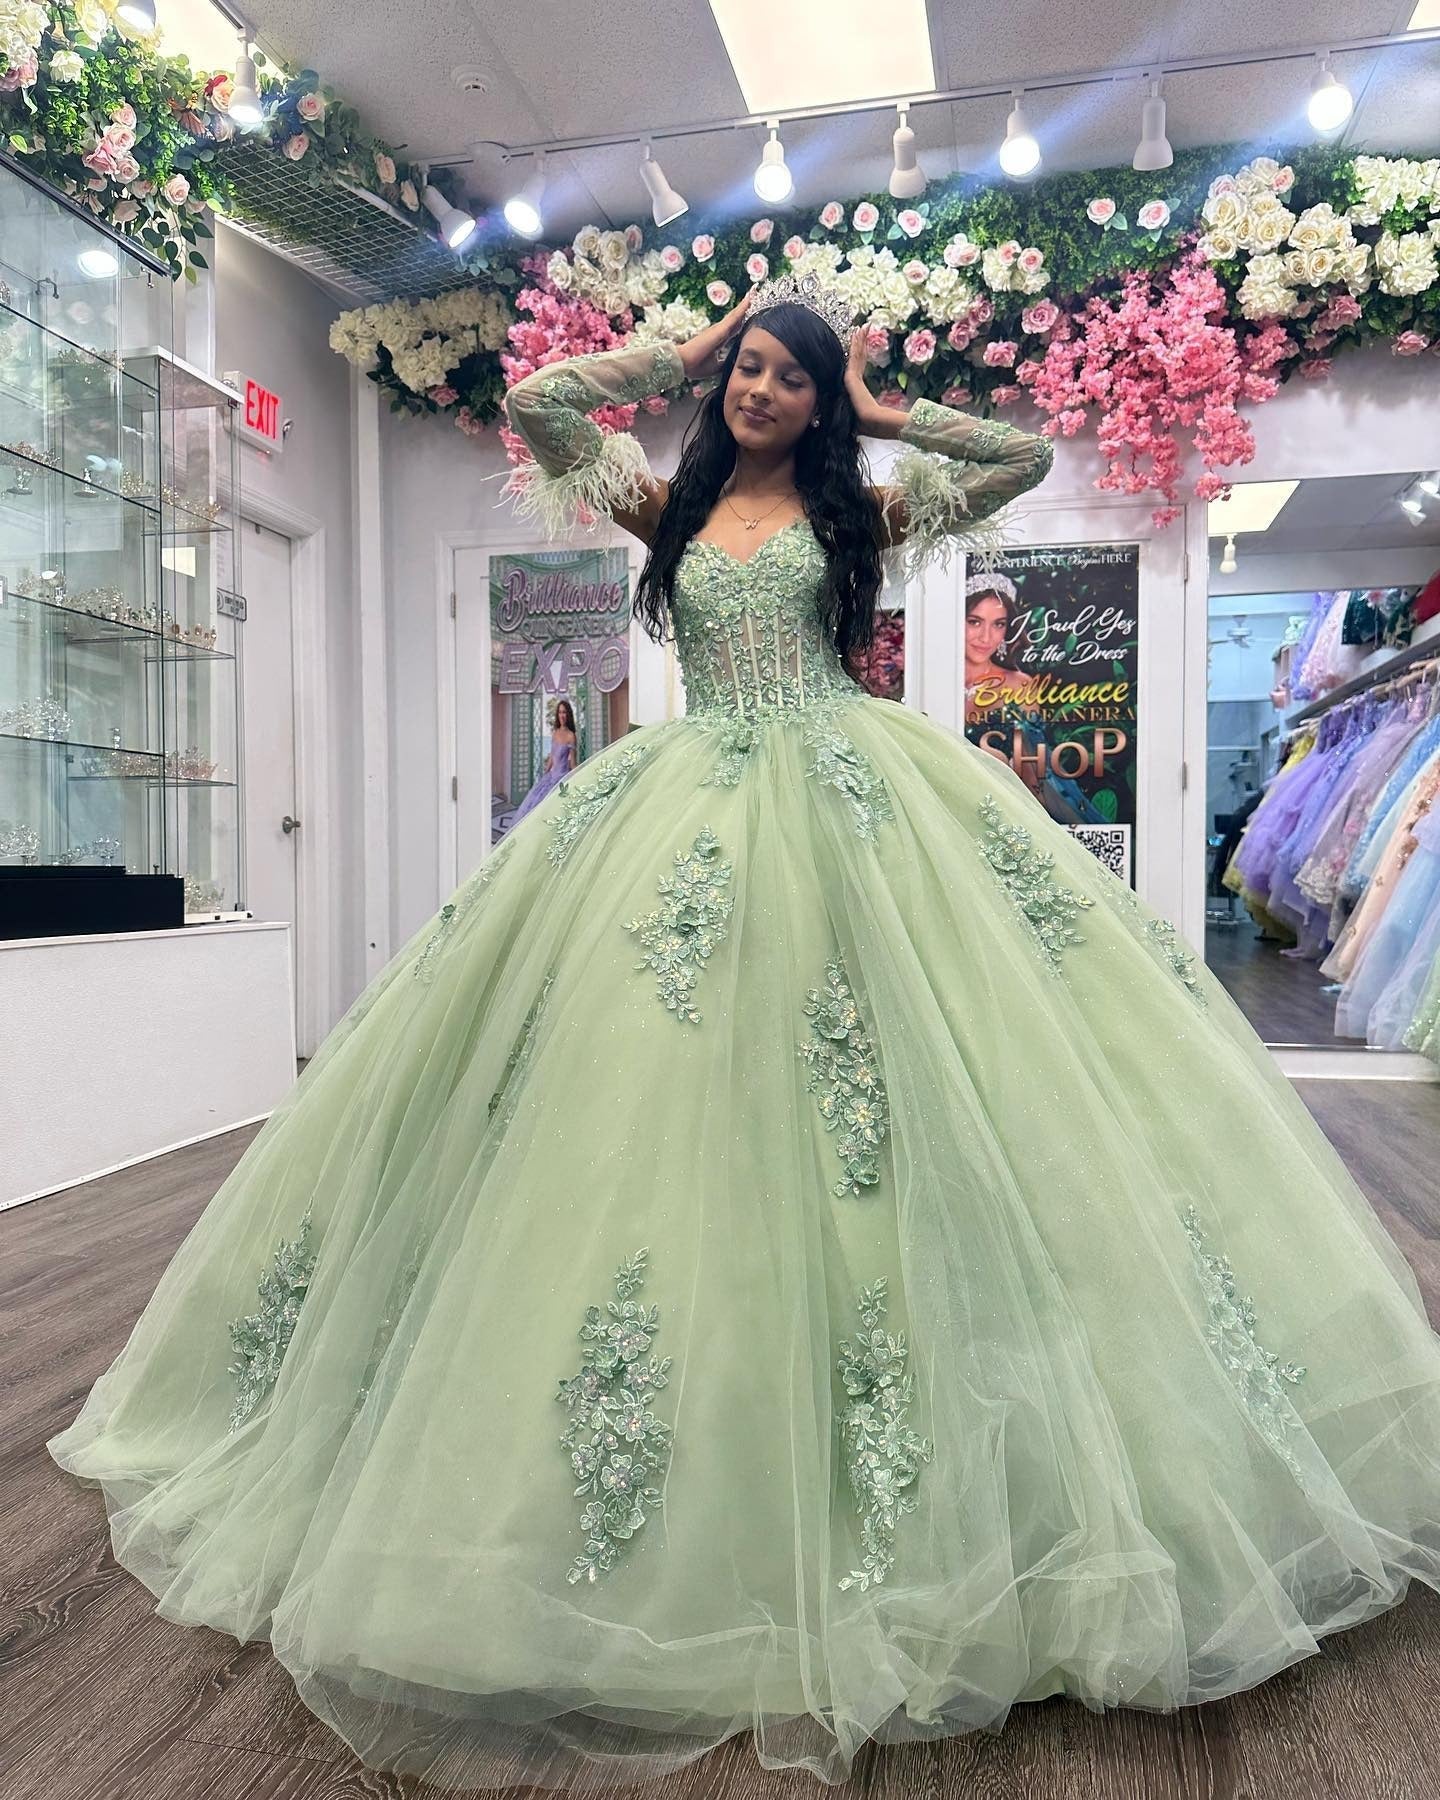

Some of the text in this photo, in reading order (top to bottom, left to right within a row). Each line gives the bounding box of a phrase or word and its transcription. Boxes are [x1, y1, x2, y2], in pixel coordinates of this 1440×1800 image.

[245, 380, 279, 440] EXIT
[997, 554, 1063, 570] EXPERIENCE
[1101, 552, 1132, 565] HERE
[496, 567, 623, 632] Brilliance
[1005, 604, 1137, 644] I Said Yes
[499, 638, 630, 694] EXPO
[1021, 640, 1129, 666] to the Dress
[973, 672, 1130, 708] Brilliance
[979, 727, 1128, 780] SHOP
